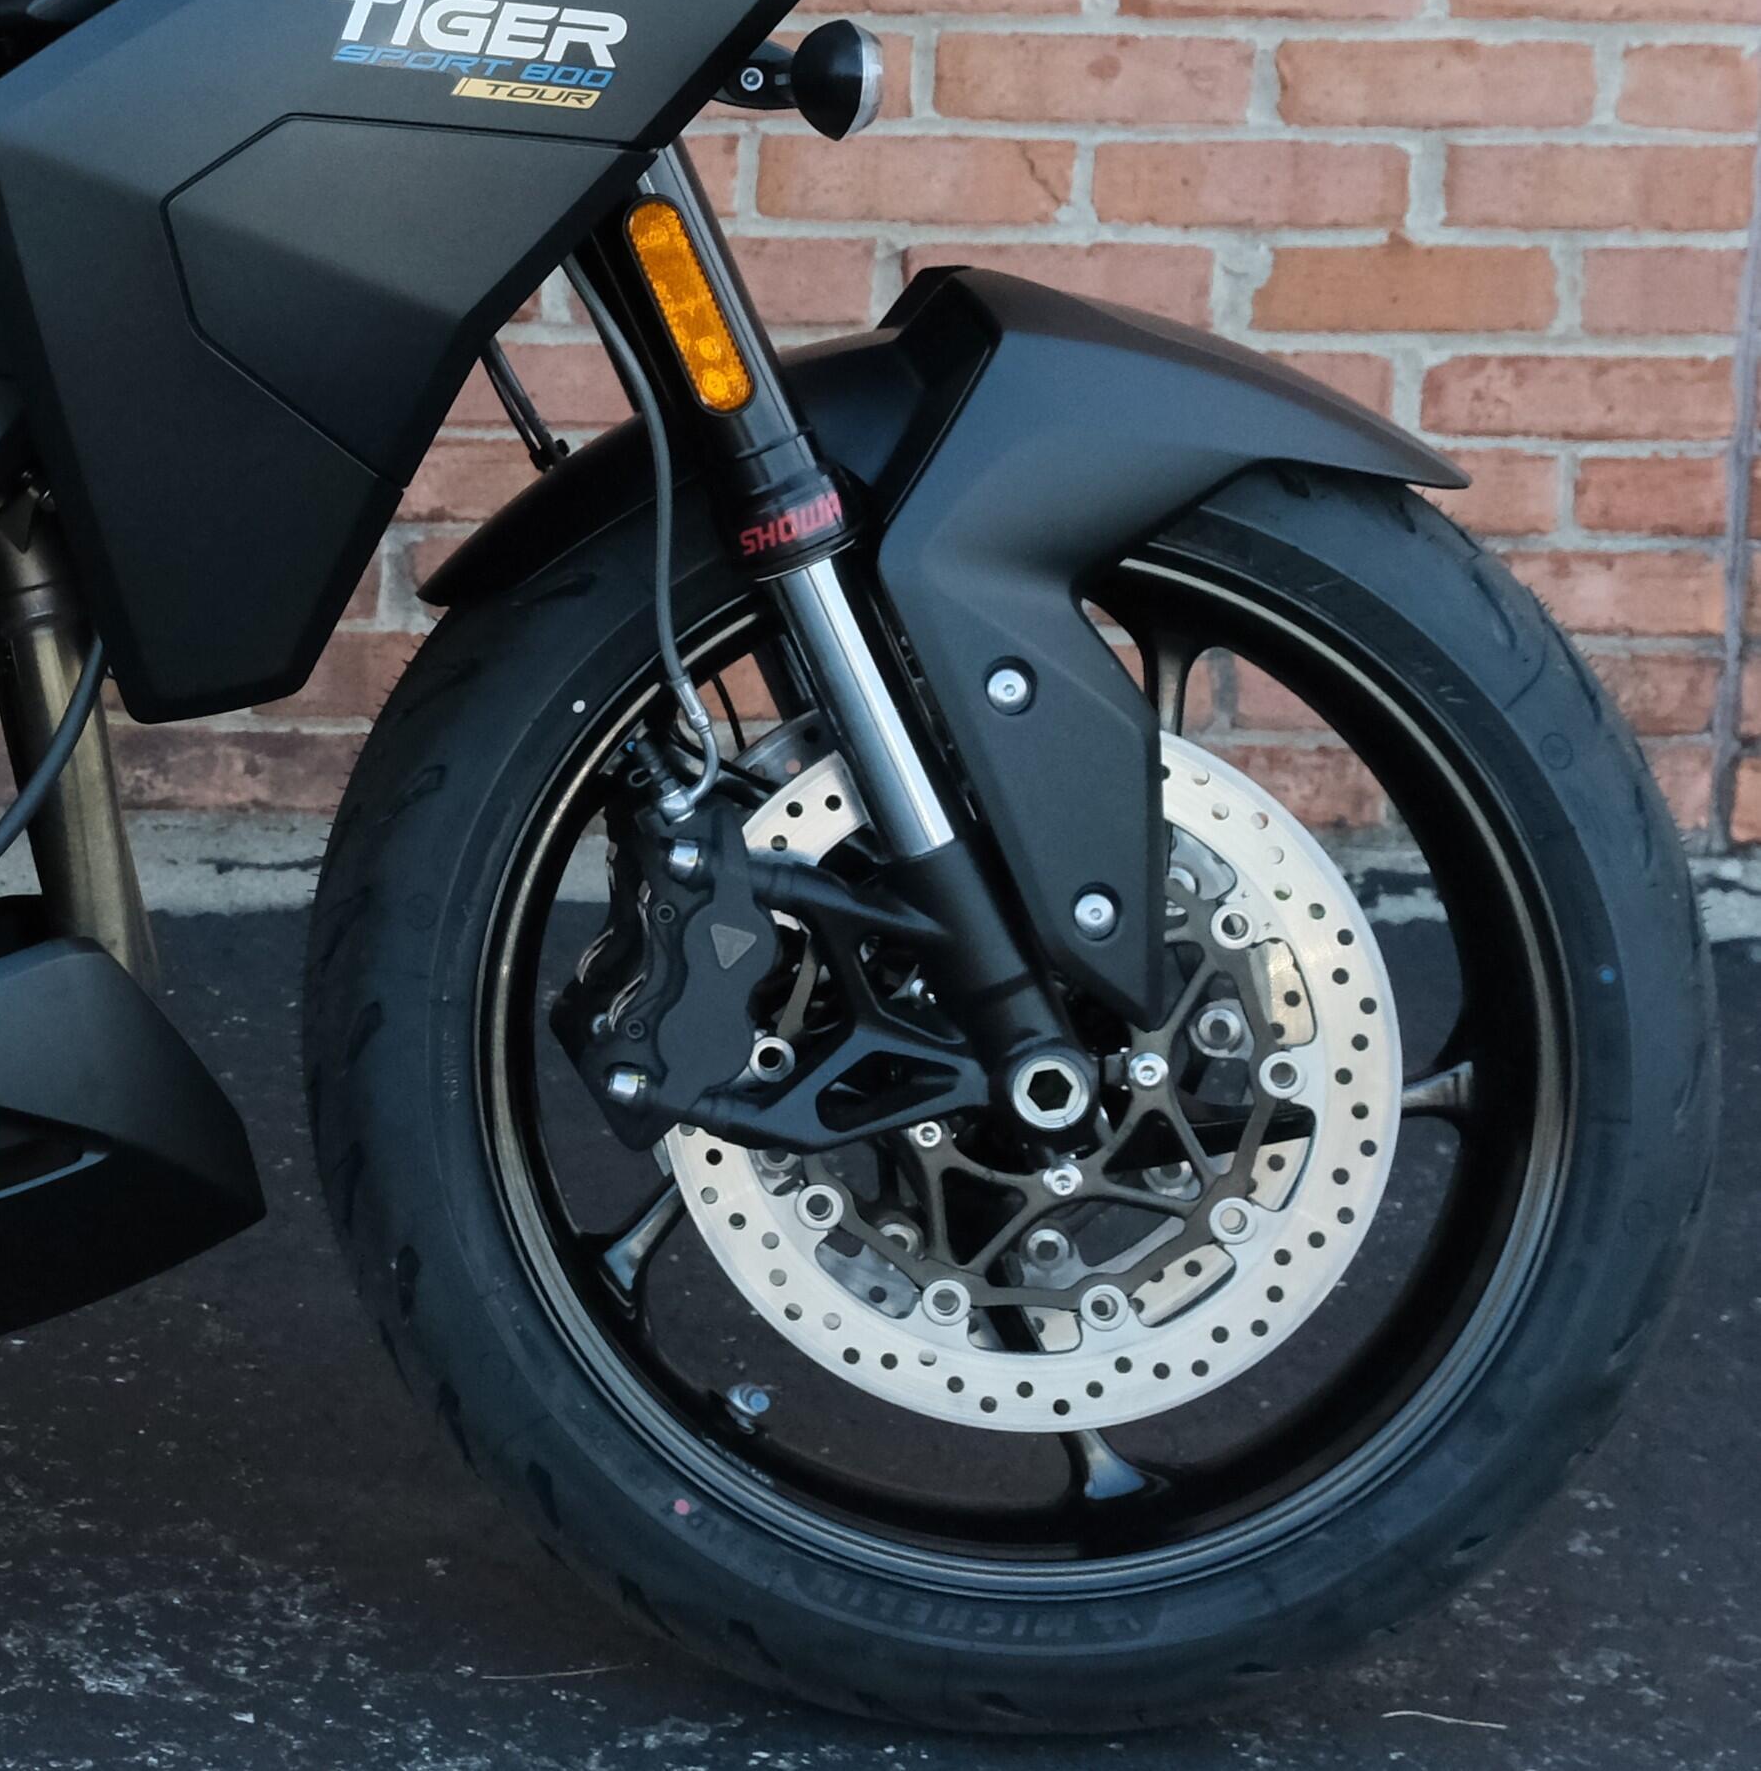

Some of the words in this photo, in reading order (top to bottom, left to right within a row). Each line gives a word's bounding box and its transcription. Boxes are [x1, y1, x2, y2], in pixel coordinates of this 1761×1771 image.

[333, 44, 513, 77] SPORT
[521, 64, 613, 88] 800
[487, 82, 593, 105] TOUR
[739, 492, 843, 556] SHOWA
[810, 1571, 1077, 1638] MICHELIN
